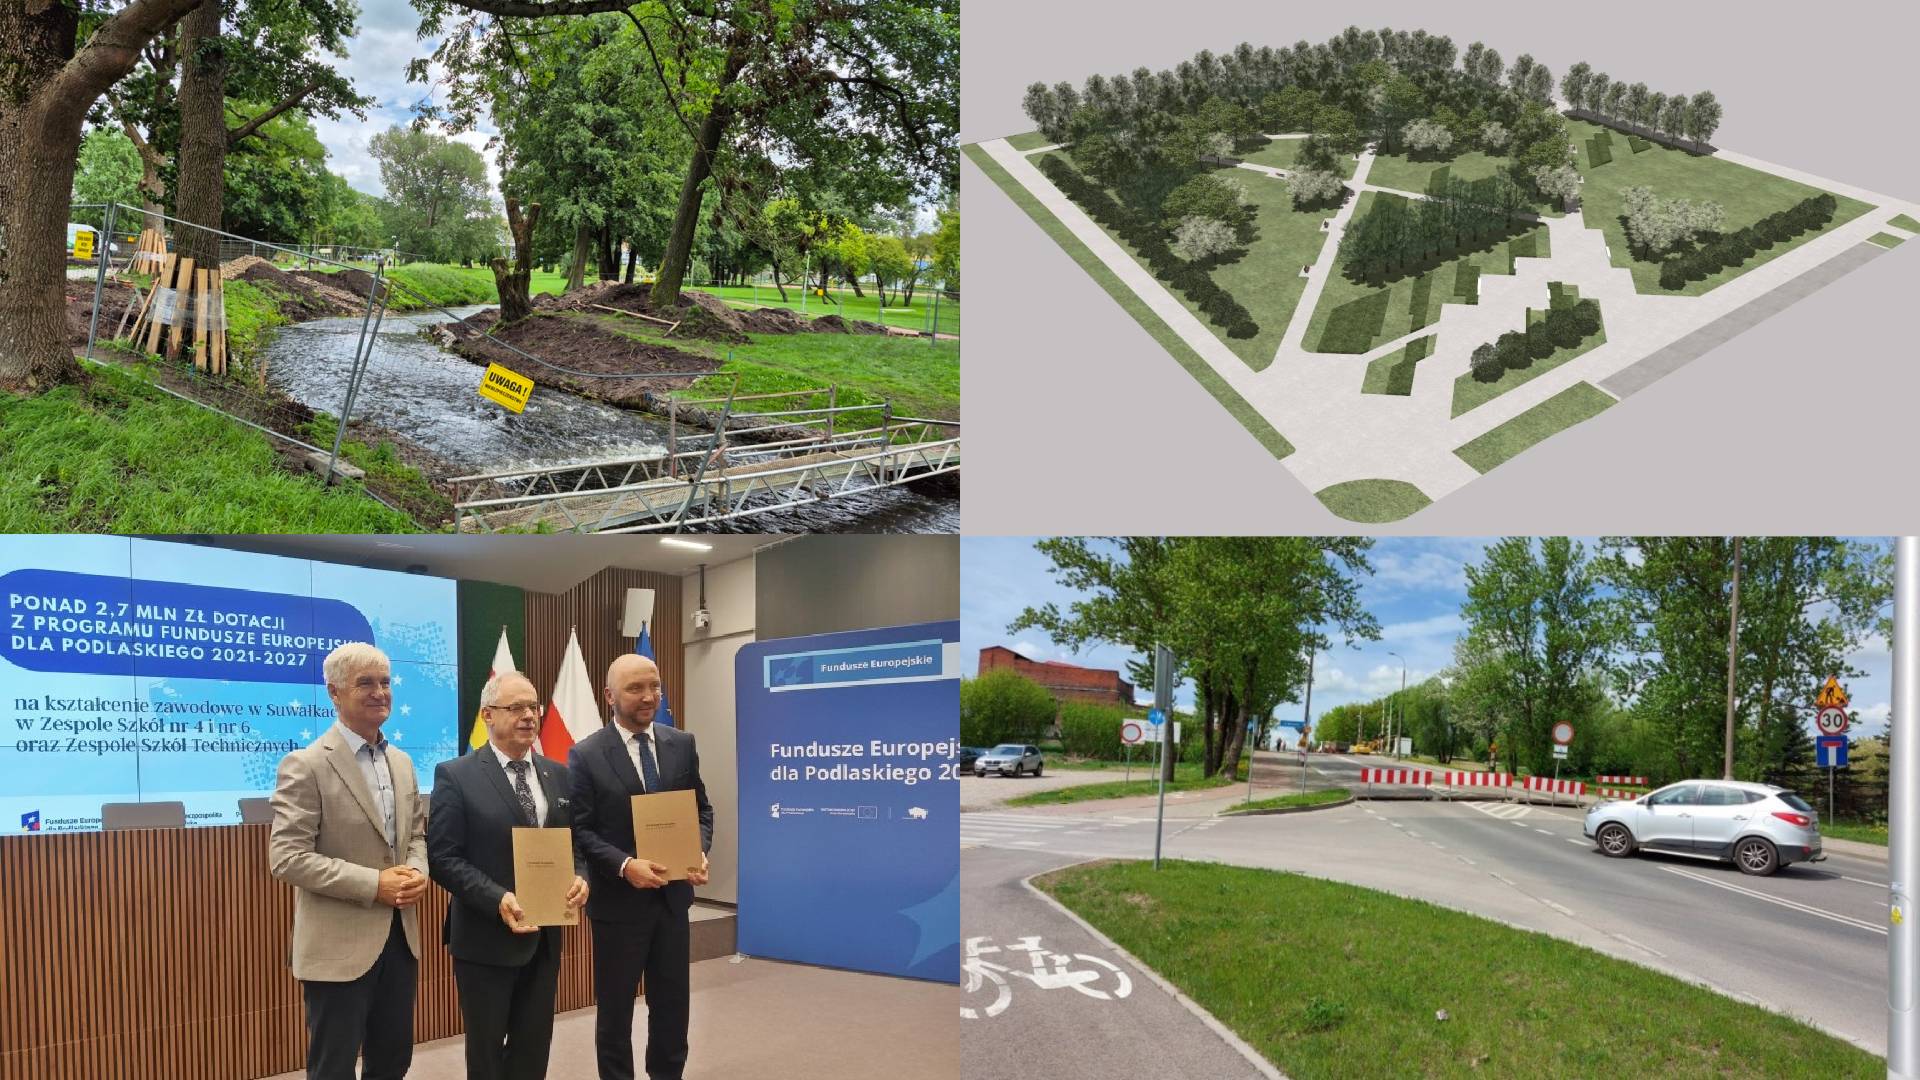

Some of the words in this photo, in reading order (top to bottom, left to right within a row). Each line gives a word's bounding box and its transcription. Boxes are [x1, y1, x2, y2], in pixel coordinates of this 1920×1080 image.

[9, 593, 87, 614] PONAD
[95, 601, 129, 618] 2,7
[136, 604, 177, 621] MLN
[184, 608, 207, 624] ZŁ
[213, 610, 285, 630] DOTACJI
[11, 614, 25, 629] Z
[34, 615, 153, 637] PROGRAMU
[161, 625, 256, 645] FUNDUSZE
[11, 635, 54, 651] DLA
[62, 638, 204, 660] PODLASKIEGO
[212, 648, 307, 666] 2021-2027
[821, 660, 868, 672] Fundusze
[870, 655, 933, 669] Europejskie
[15, 698, 39, 711] na
[45, 694, 149, 713] kształcenie
[154, 700, 243, 716] zawodowe
[248, 704, 263, 716] w
[266, 703, 338, 719] Suwałkac
[15, 718, 35, 731] w
[40, 716, 113, 735] Zespole
[117, 717, 165, 733] Szkół
[170, 721, 189, 733] nr
[193, 720, 204, 733] 4
[208, 718, 215, 733] i
[218, 721, 237, 734] nr
[241, 720, 251, 734] 6
[1822, 713, 1843, 728] 30
[16, 738, 59, 753] oraz
[66, 738, 136, 757] Zespole
[141, 738, 187, 753] Szkół
[192, 738, 299, 756] Technicznych
[770, 740, 864, 758] Fundusze
[770, 764, 799, 781] dla
[805, 763, 932, 785] Podlaskiego
